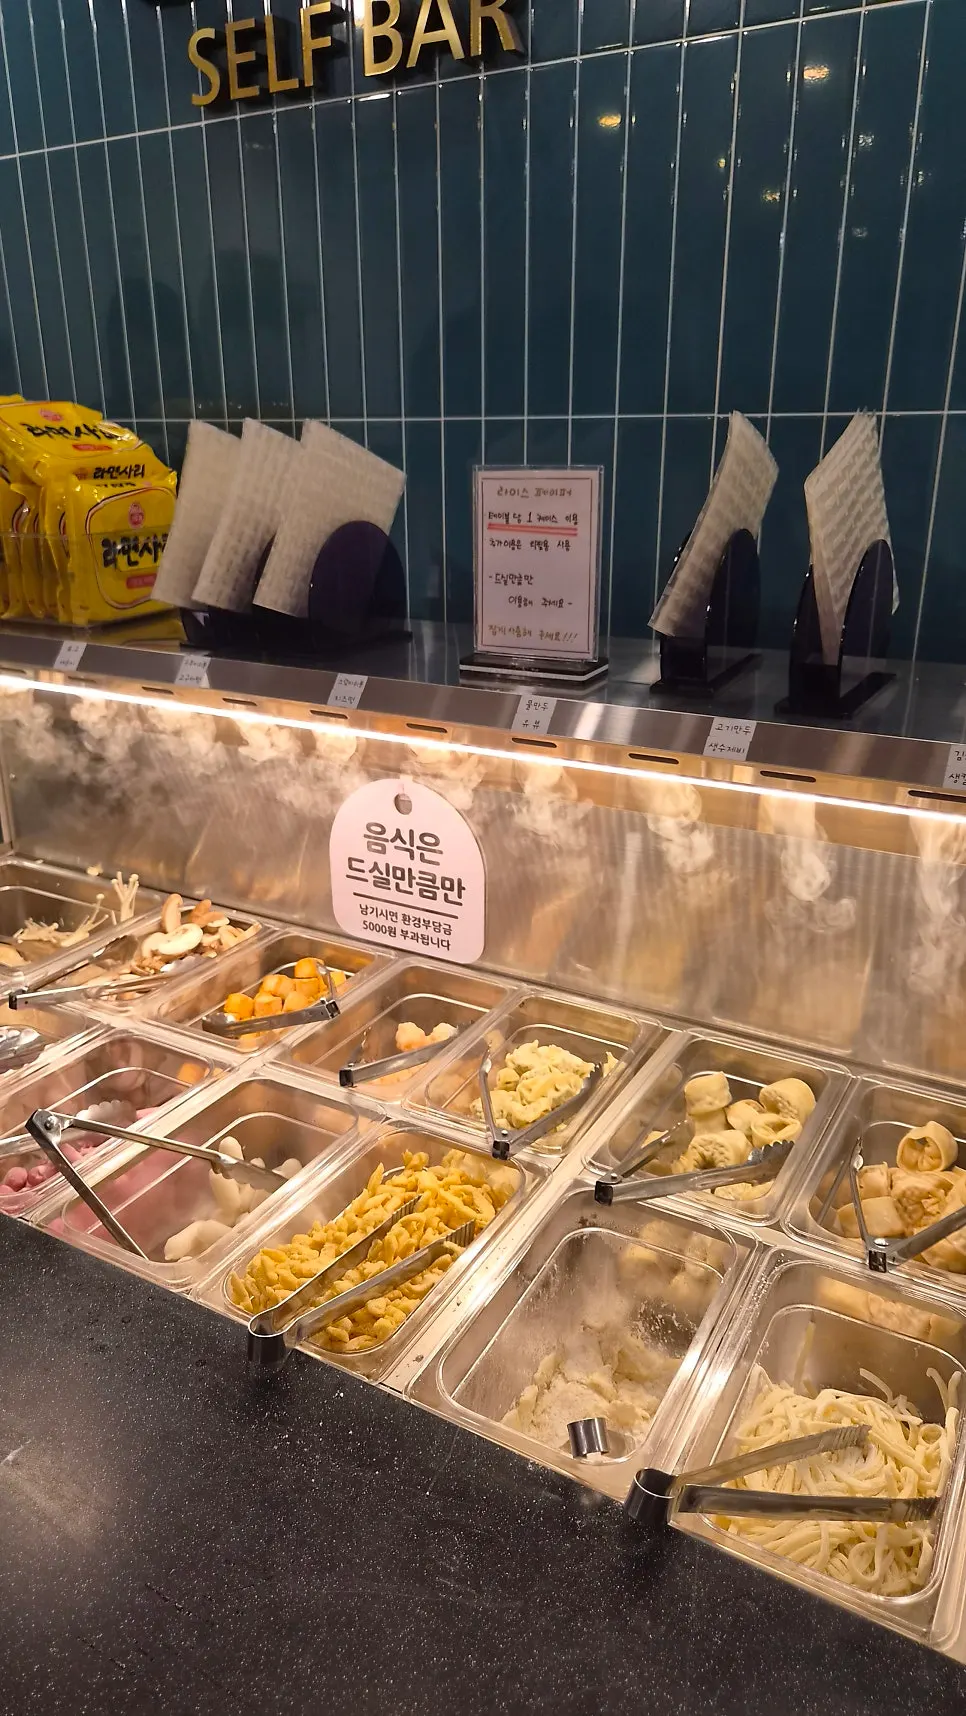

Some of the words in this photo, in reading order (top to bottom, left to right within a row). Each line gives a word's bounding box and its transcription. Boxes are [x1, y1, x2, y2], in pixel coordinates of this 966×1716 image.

[188, 2, 332, 106] SELF
[363, 0, 518, 76] BAR
[93, 463, 146, 480] 라면사리
[497, 486, 529, 498] 라이스
[564, 513, 578, 526] 이용
[556, 539, 571, 552] 사용
[525, 699, 549, 711] 물만두
[714, 723, 752, 736] 고기만두
[363, 822, 444, 866] 음식은
[345, 856, 466, 907] 드실만큼만
[359, 903, 399, 923] 남기시면
[401, 912, 453, 936] 환경부담금
[362, 920, 398, 938] 5000원
[400, 928, 452, 951] 부과됩니다
